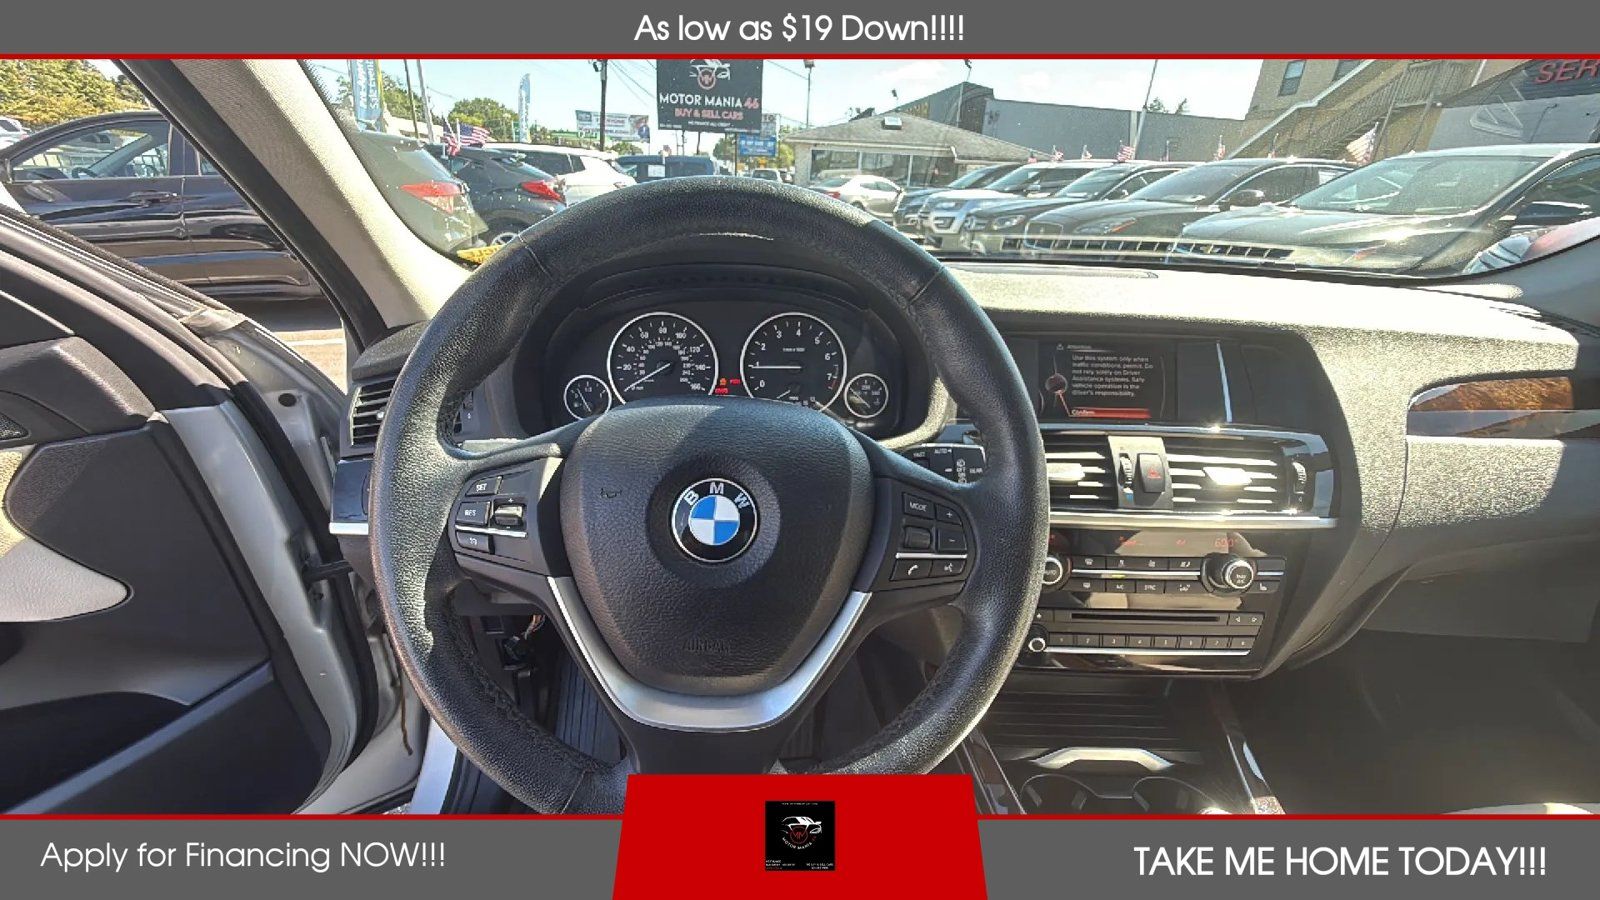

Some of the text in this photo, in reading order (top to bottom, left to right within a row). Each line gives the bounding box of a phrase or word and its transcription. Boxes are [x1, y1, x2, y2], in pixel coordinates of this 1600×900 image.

[659, 93, 759, 109] MOTOR MANIA 46
[674, 108, 744, 120] BUY & SELL CARS
[776, 330, 782, 339] 3
[796, 328, 801, 336] 4
[815, 336, 821, 345] 5
[761, 342, 766, 351] 2
[824, 353, 831, 361] 6
[476, 483, 488, 492] SET
[683, 481, 750, 509] BMW
[909, 501, 927, 512] MODE
